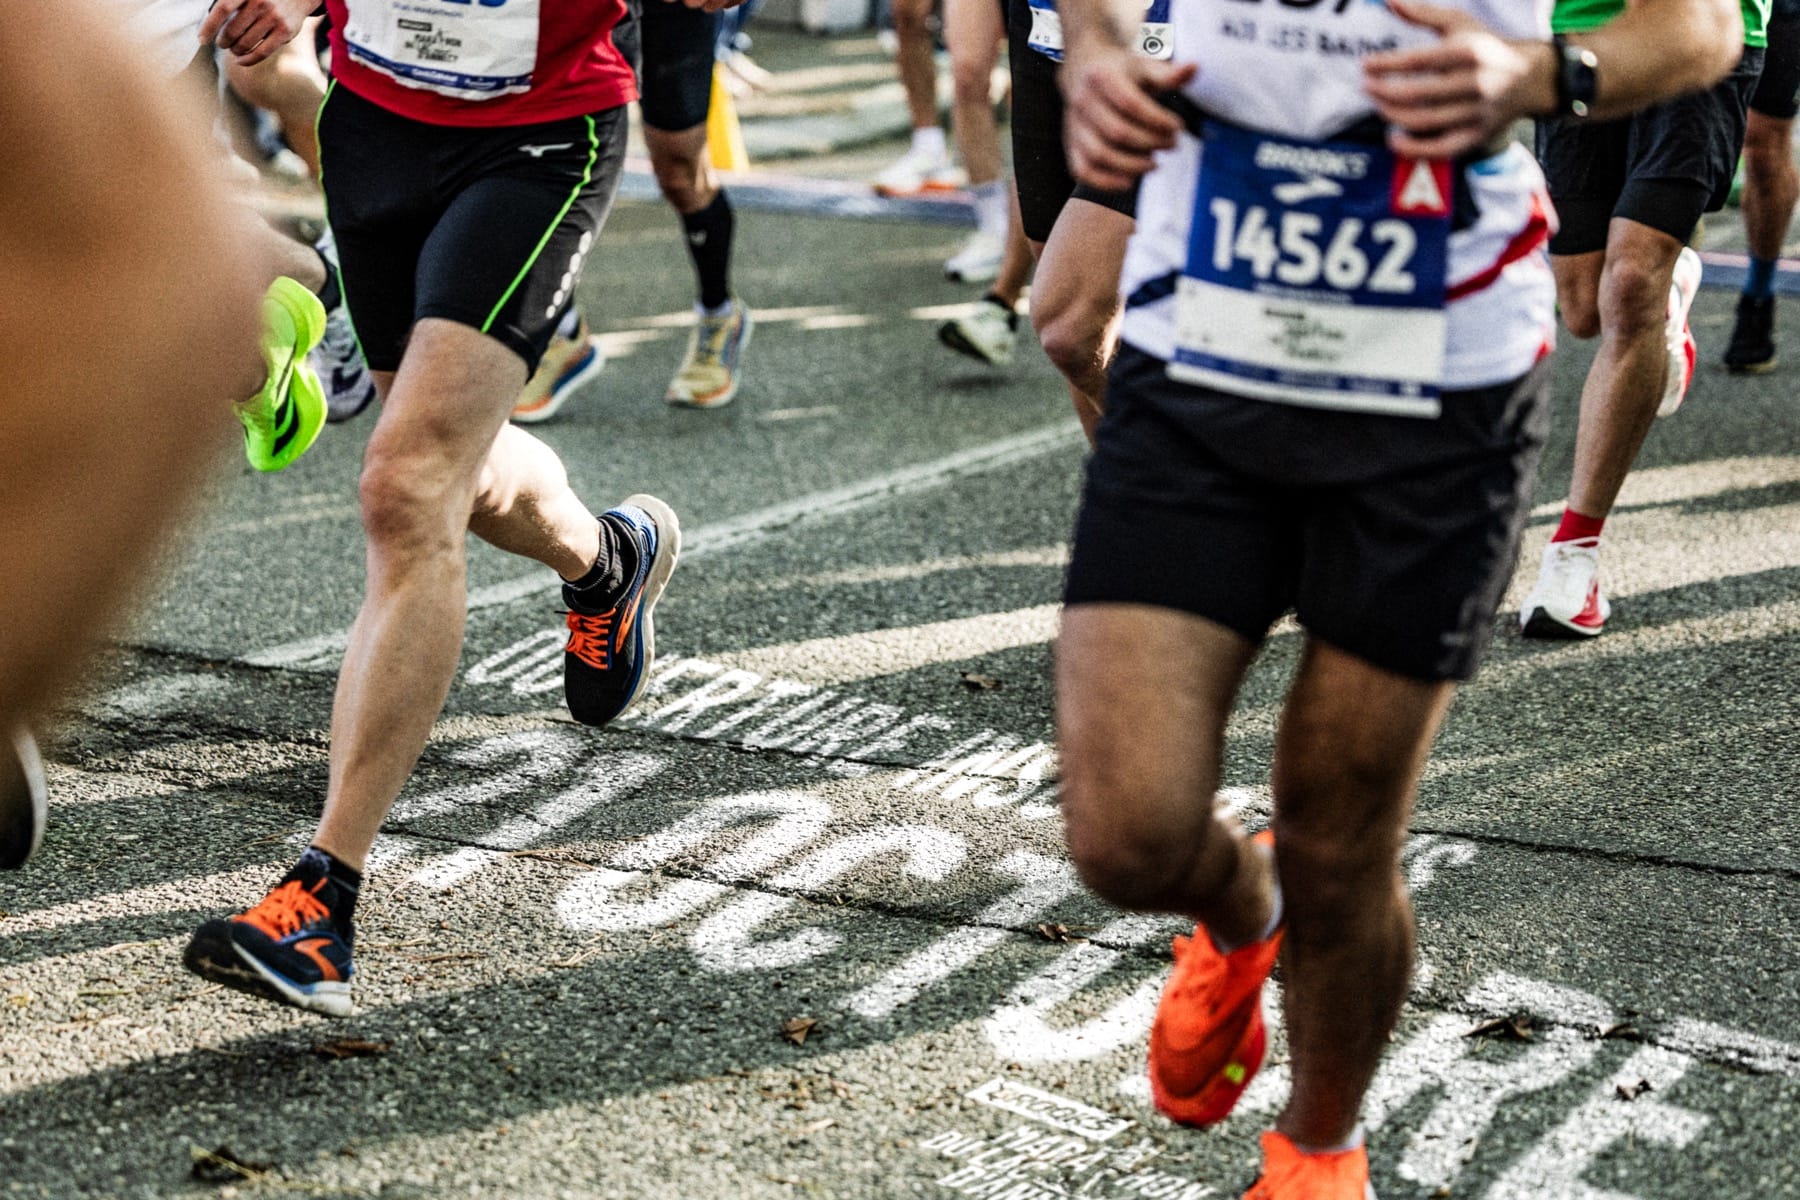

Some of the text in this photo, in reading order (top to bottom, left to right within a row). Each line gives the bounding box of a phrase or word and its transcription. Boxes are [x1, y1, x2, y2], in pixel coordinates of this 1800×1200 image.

[1253, 141, 1371, 180] BROOKS
[1399, 157, 1446, 210] A
[1208, 196, 1418, 294] 14562
[464, 628, 954, 777] OUERTURE
[555, 788, 1800, 1200] OCTORE
[919, 1129, 987, 1156] DU
